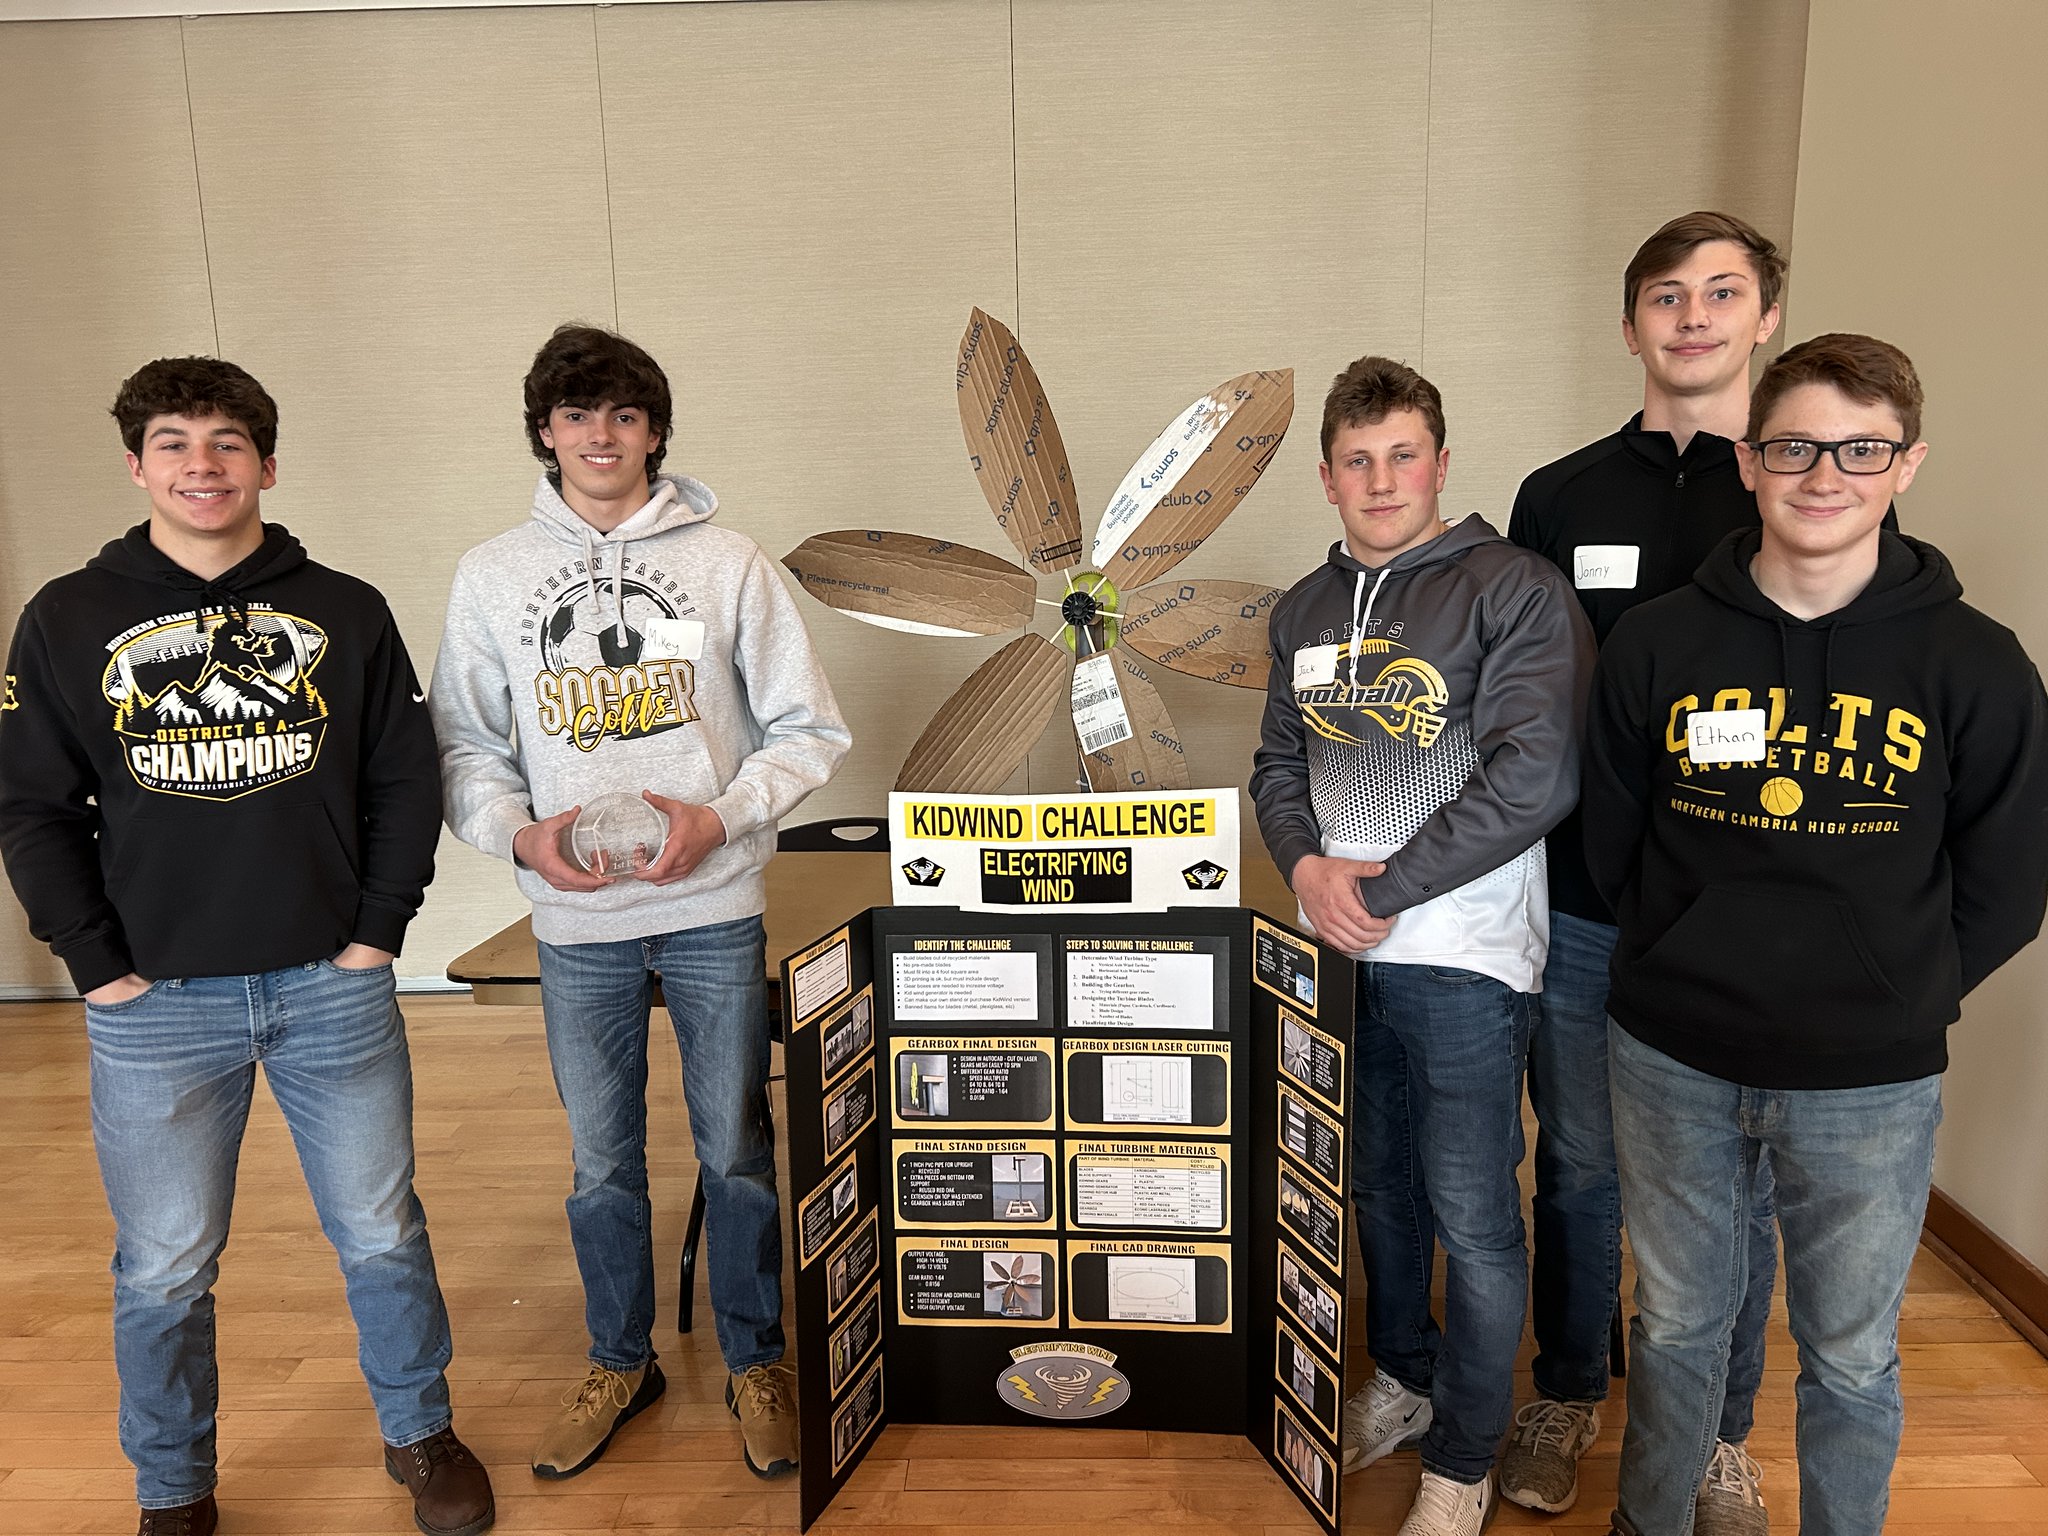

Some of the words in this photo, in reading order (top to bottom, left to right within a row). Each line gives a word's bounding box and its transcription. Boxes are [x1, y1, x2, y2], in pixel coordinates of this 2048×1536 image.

[986, 396, 1005, 435] sam's
[1000, 365, 1013, 395] club
[1151, 448, 1178, 481] sam's
[1110, 493, 1129, 516] special
[1161, 493, 1191, 507] club
[1106, 499, 1134, 529] something
[1122, 503, 1140, 524] expect
[1576, 555, 1610, 580] Jonny
[807, 573, 837, 586] Please
[838, 579, 872, 592] recycle
[873, 585, 890, 595] me!
[521, 557, 603, 646] NORTHERN
[621, 557, 696, 616] CAMBRI
[1151, 598, 1178, 618] club
[105, 619, 158, 653] NORTHERN
[649, 629, 680, 656] Mikey
[1186, 625, 1221, 650] sam's
[1158, 647, 1186, 663] club
[1298, 664, 1315, 677] Jack
[534, 659, 701, 735] SOCCER
[572, 686, 671, 752] Colts
[157, 724, 244, 743] DISTRICT
[255, 721, 266, 734] 6
[276, 719, 288, 732] A
[1150, 730, 1183, 754] sam's
[1695, 725, 1755, 746] Ethan
[131, 732, 312, 782] CHAMPIONS
[257, 772, 281, 784] ELITE
[285, 763, 306, 776] EIGHT
[913, 805, 1024, 839] KIDWIND
[1042, 802, 1206, 838] CHALLENGE
[1671, 798, 1725, 822] NORTHERN
[1731, 812, 1798, 832] CAMBRIA
[1808, 821, 1845, 834] HIGH
[1851, 821, 1899, 834] SCHOOL
[627, 858, 648, 868] Place
[984, 851, 1127, 876] ELECTRIFYING
[1021, 879, 1074, 902] WIND
[914, 939, 948, 951] IDENTIFY
[950, 940, 965, 951] THE
[967, 939, 1012, 951] CHALLENGE
[1066, 940, 1089, 950] STEPS
[1091, 940, 1100, 950] TO
[1102, 940, 1133, 950] SOLVING
[1135, 941, 1149, 951] THE
[1151, 941, 1194, 952] CHALLENGE
[1281, 932, 1300, 948] DESIGNS
[1282, 1009, 1294, 1022] BLADE
[1295, 1017, 1310, 1032] DESIGN
[1311, 1026, 1332, 1046] CONCEPT
[908, 1040, 959, 1049] GEARBOX
[963, 1040, 993, 1049] FINAL
[997, 1040, 1037, 1048] DESIGN
[1063, 1041, 1109, 1051] GEARBOX
[1113, 1041, 1149, 1051] DESIGN
[1152, 1042, 1182, 1051] LASER
[1187, 1043, 1229, 1053] CUTTING
[1293, 1093, 1307, 1109] DESIGN
[1308, 1104, 1328, 1125] CONCEPT
[915, 1142, 944, 1151] FINAL
[949, 1142, 982, 1151] STAND
[987, 1142, 1026, 1150] DESIGN
[1078, 1143, 1107, 1153] FINAL
[1111, 1144, 1155, 1153] TURBINE
[1159, 1145, 1216, 1155] MATERIALS
[1296, 1173, 1310, 1190] DESIGN
[941, 1240, 967, 1248] FINAL
[972, 1240, 1009, 1249] DESIGN
[1090, 1243, 1118, 1252] FINAL
[1122, 1243, 1143, 1252] CAD
[1147, 1244, 1195, 1254] DRAWING
[1012, 1343, 1085, 1359] ELECTRIFYING
[1087, 1346, 1115, 1362] WIND
